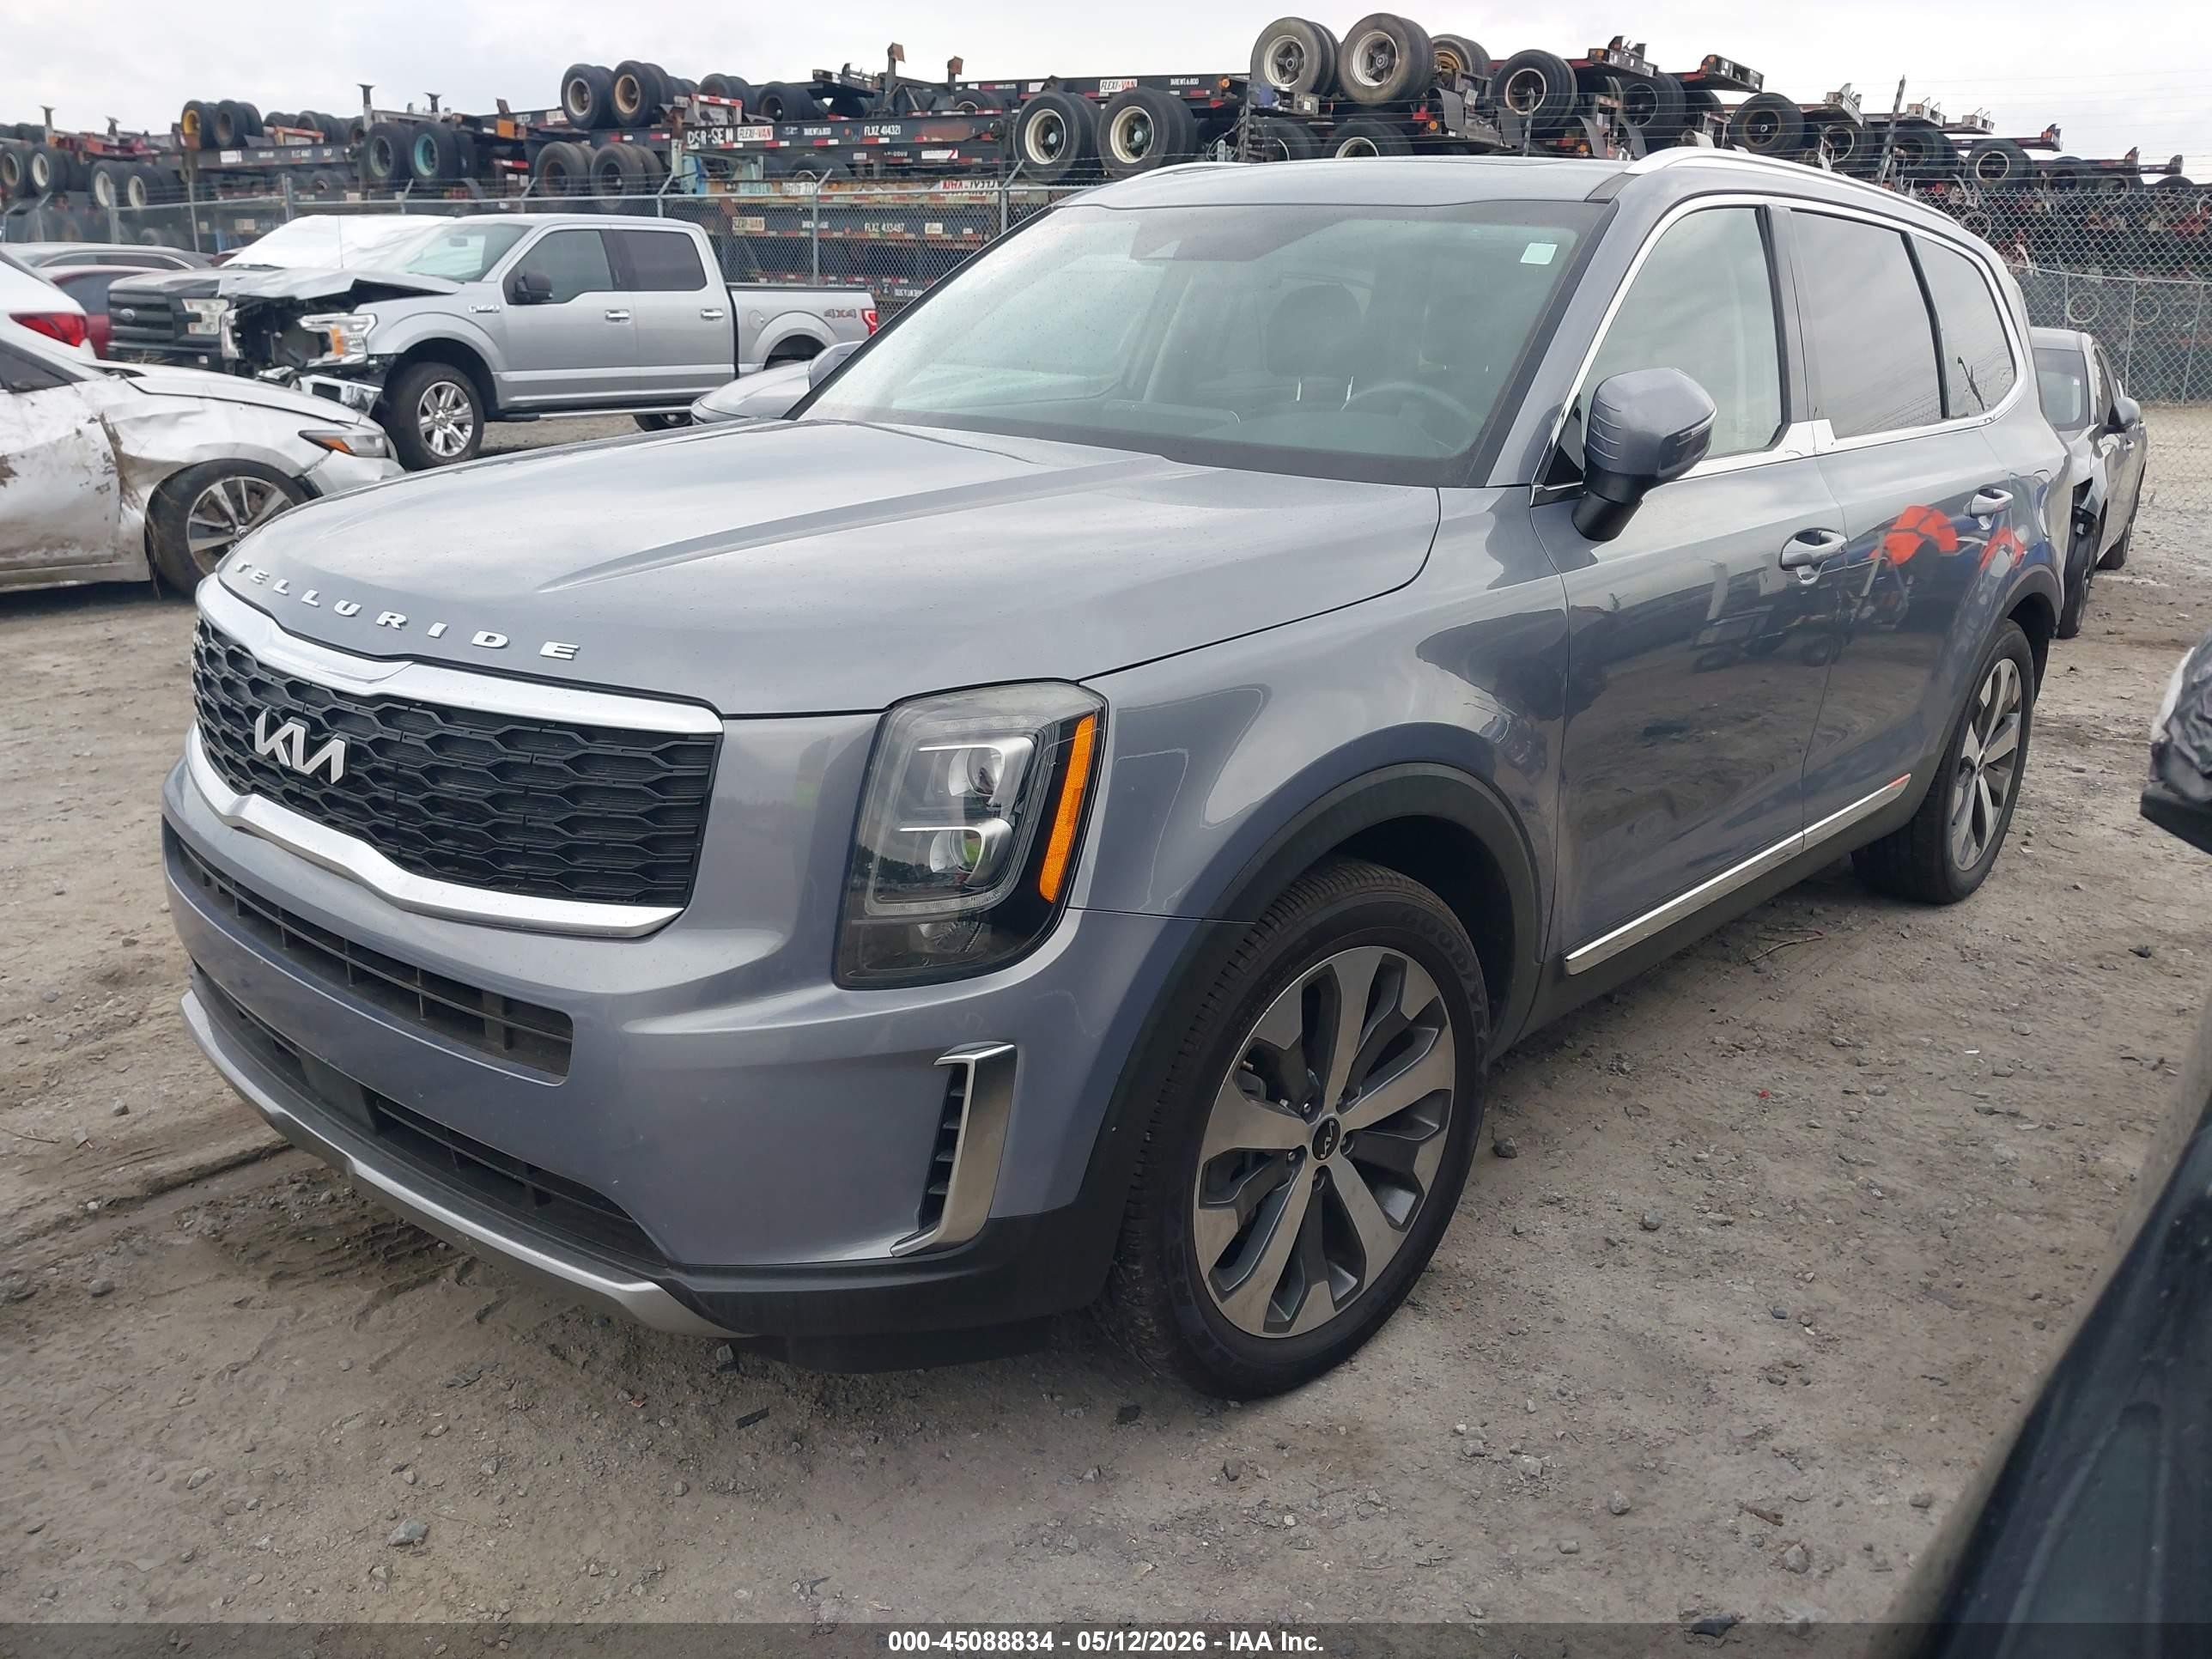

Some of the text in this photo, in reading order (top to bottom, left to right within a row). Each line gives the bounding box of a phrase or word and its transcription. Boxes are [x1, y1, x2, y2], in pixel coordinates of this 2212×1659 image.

[1101, 80, 1137, 90] FLEXI-VAN
[738, 127, 772, 140] FLEXI-VAN
[234, 561, 581, 660] TELLURIDE
[254, 709, 346, 785] KIA
